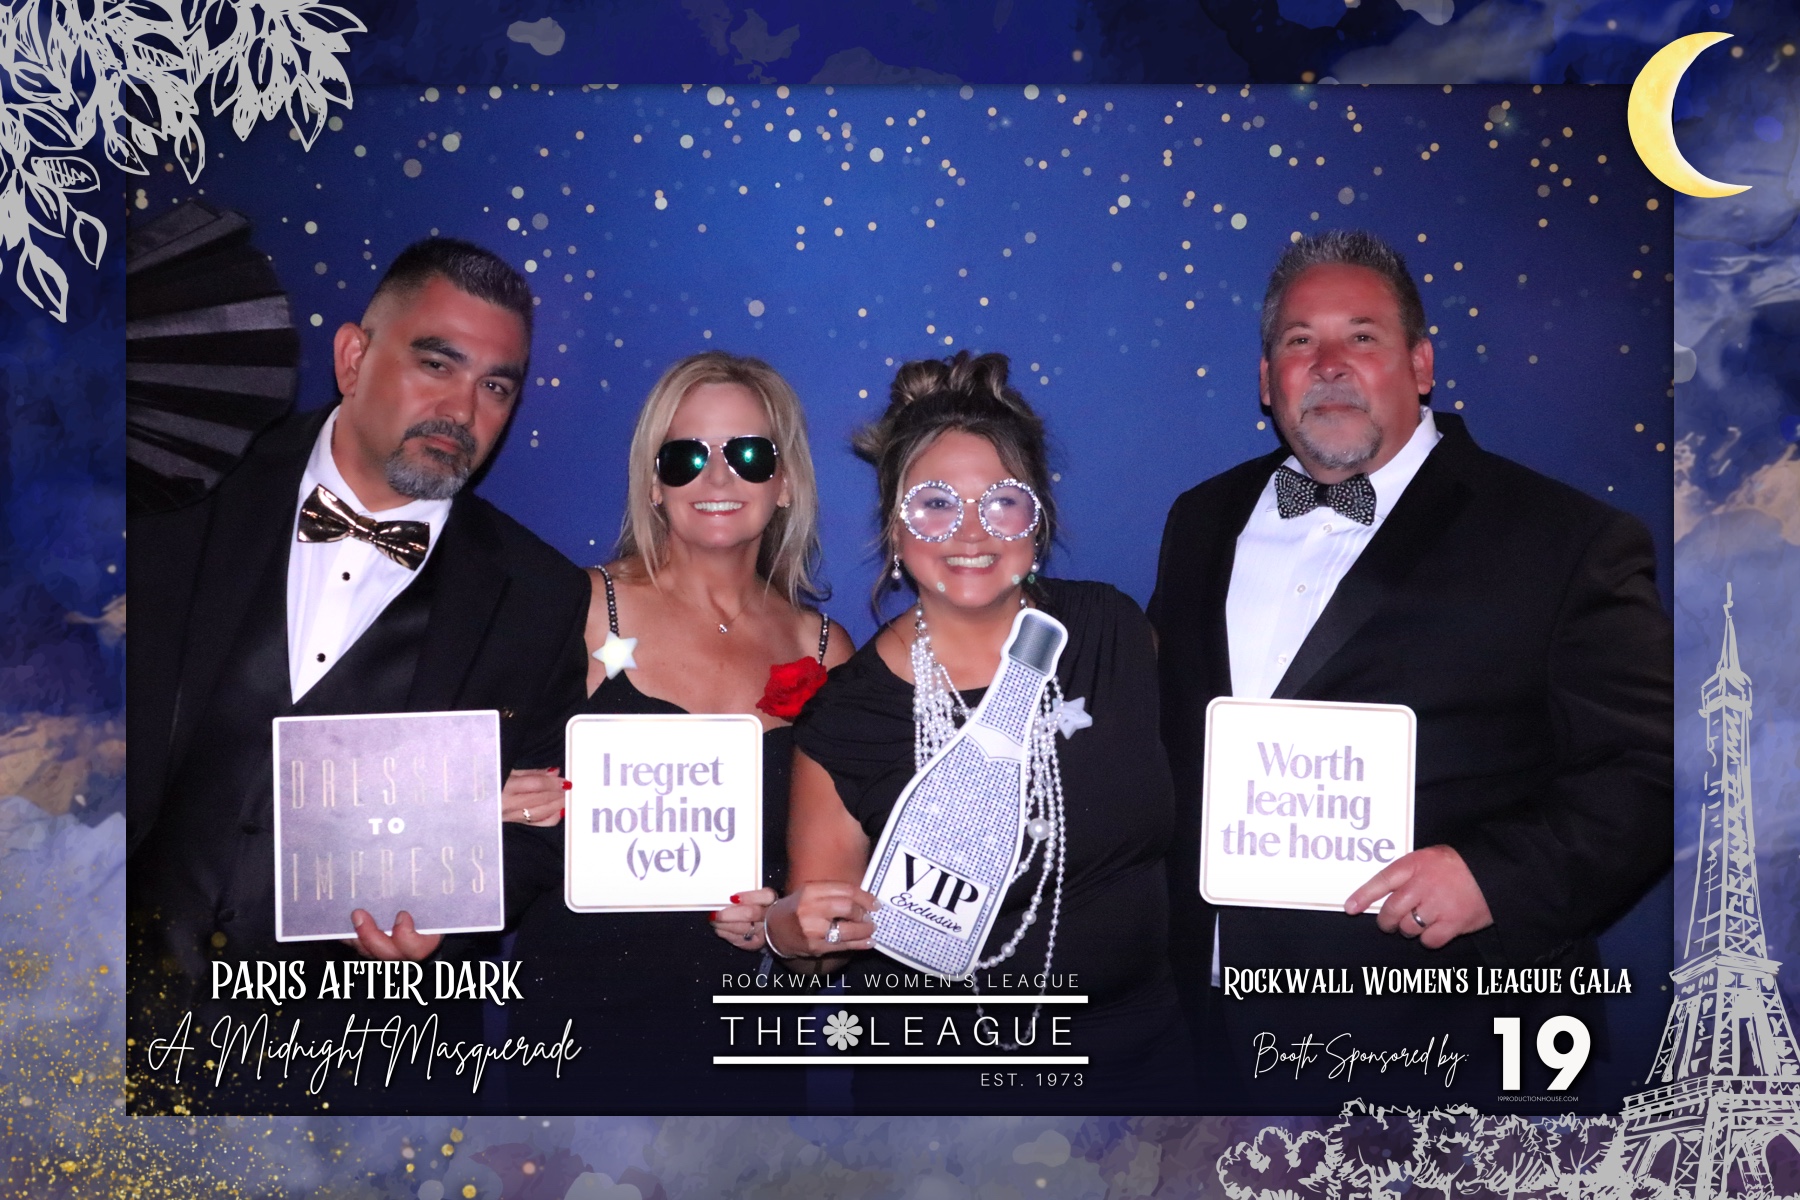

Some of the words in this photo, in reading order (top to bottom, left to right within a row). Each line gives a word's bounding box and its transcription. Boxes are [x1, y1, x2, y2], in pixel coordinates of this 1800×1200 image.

[292, 754, 486, 809] DRESSED
[603, 753, 610, 786] I
[620, 756, 724, 795] regret
[1257, 741, 1364, 782] Worth
[368, 817, 405, 835] TO
[592, 795, 735, 842] nothing
[1246, 780, 1371, 830] leaving
[627, 837, 701, 880] (yet)
[1220, 820, 1281, 857] the
[1289, 823, 1396, 863] house
[293, 845, 485, 901] IMPRESS
[903, 852, 979, 915] VIP
[890, 892, 962, 933] Exclusive
